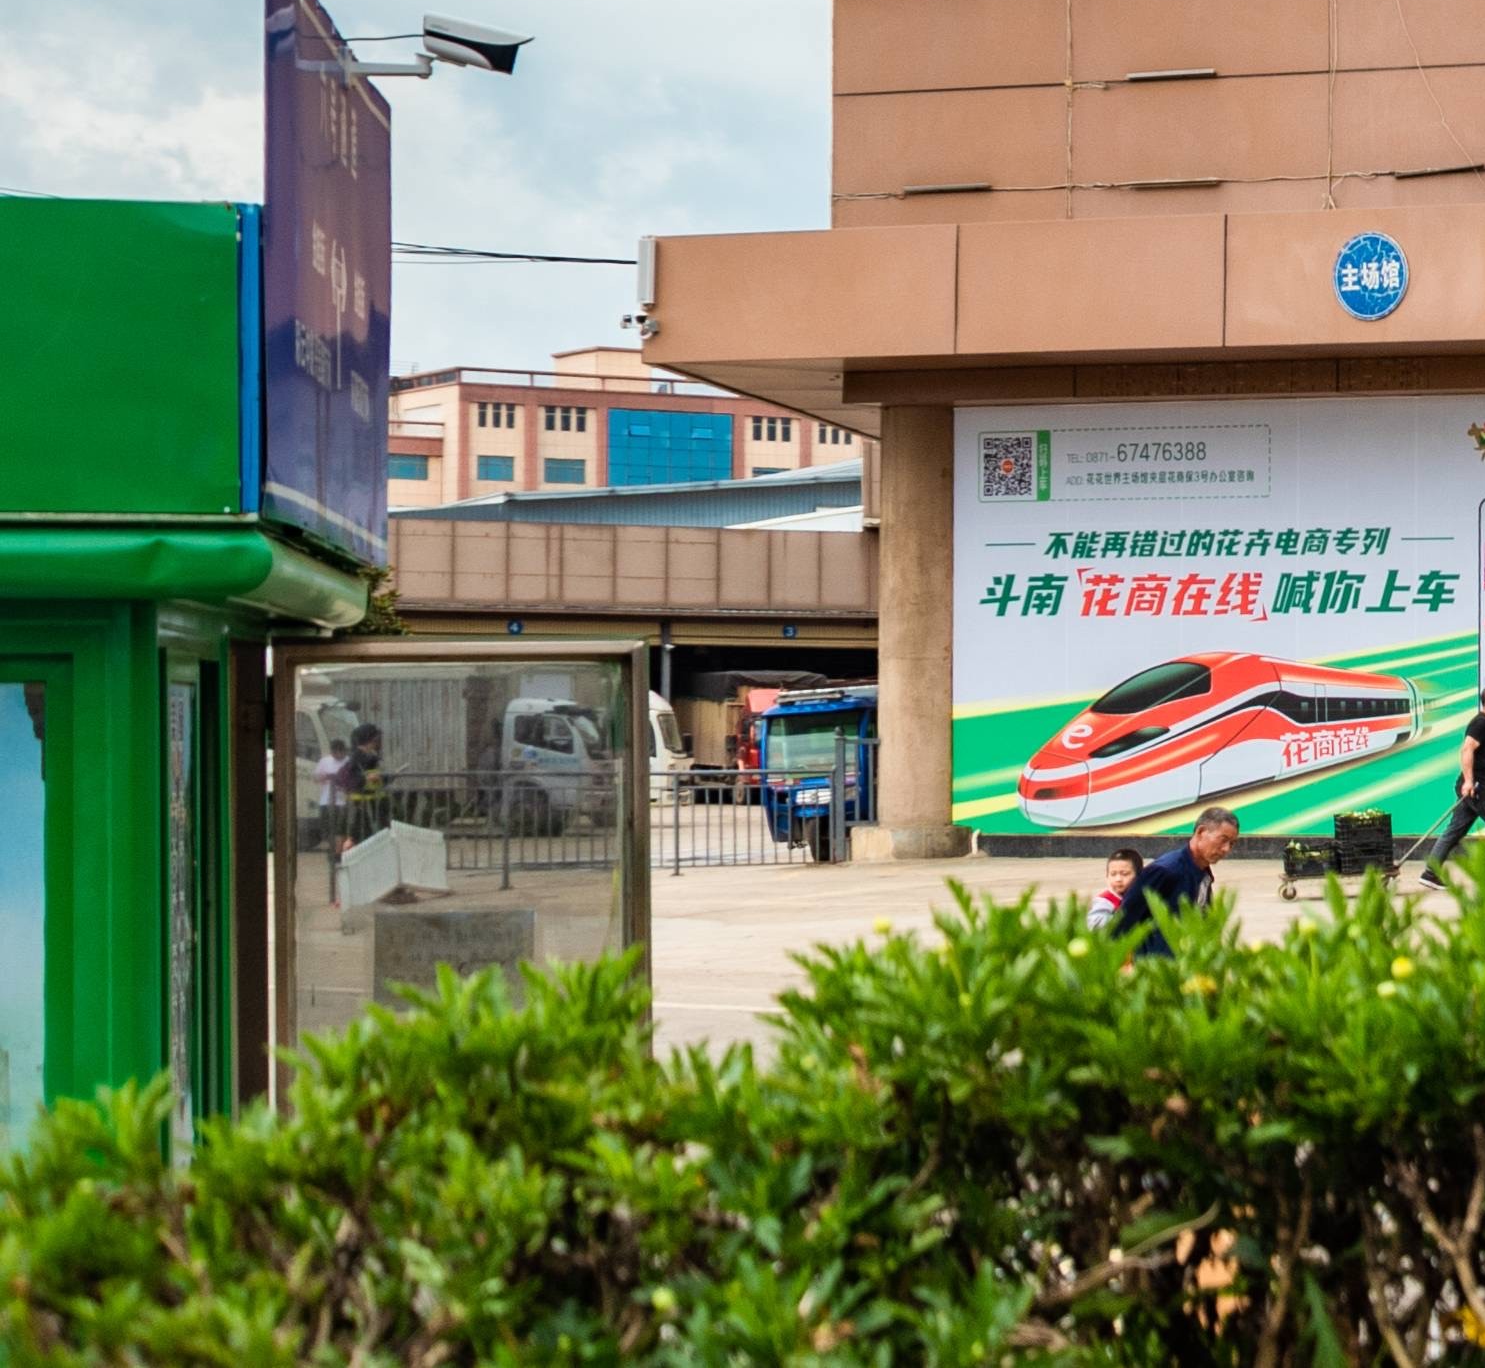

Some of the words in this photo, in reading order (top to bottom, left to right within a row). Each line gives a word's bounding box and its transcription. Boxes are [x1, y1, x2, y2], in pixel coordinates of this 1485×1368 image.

[1340, 260, 1400, 292] 主场馆
[1086, 441, 1207, 464] 0871-67476388
[1044, 527, 1390, 560] 不能再错过的花卉电商专列
[1280, 725, 1370, 769] 花商在线
